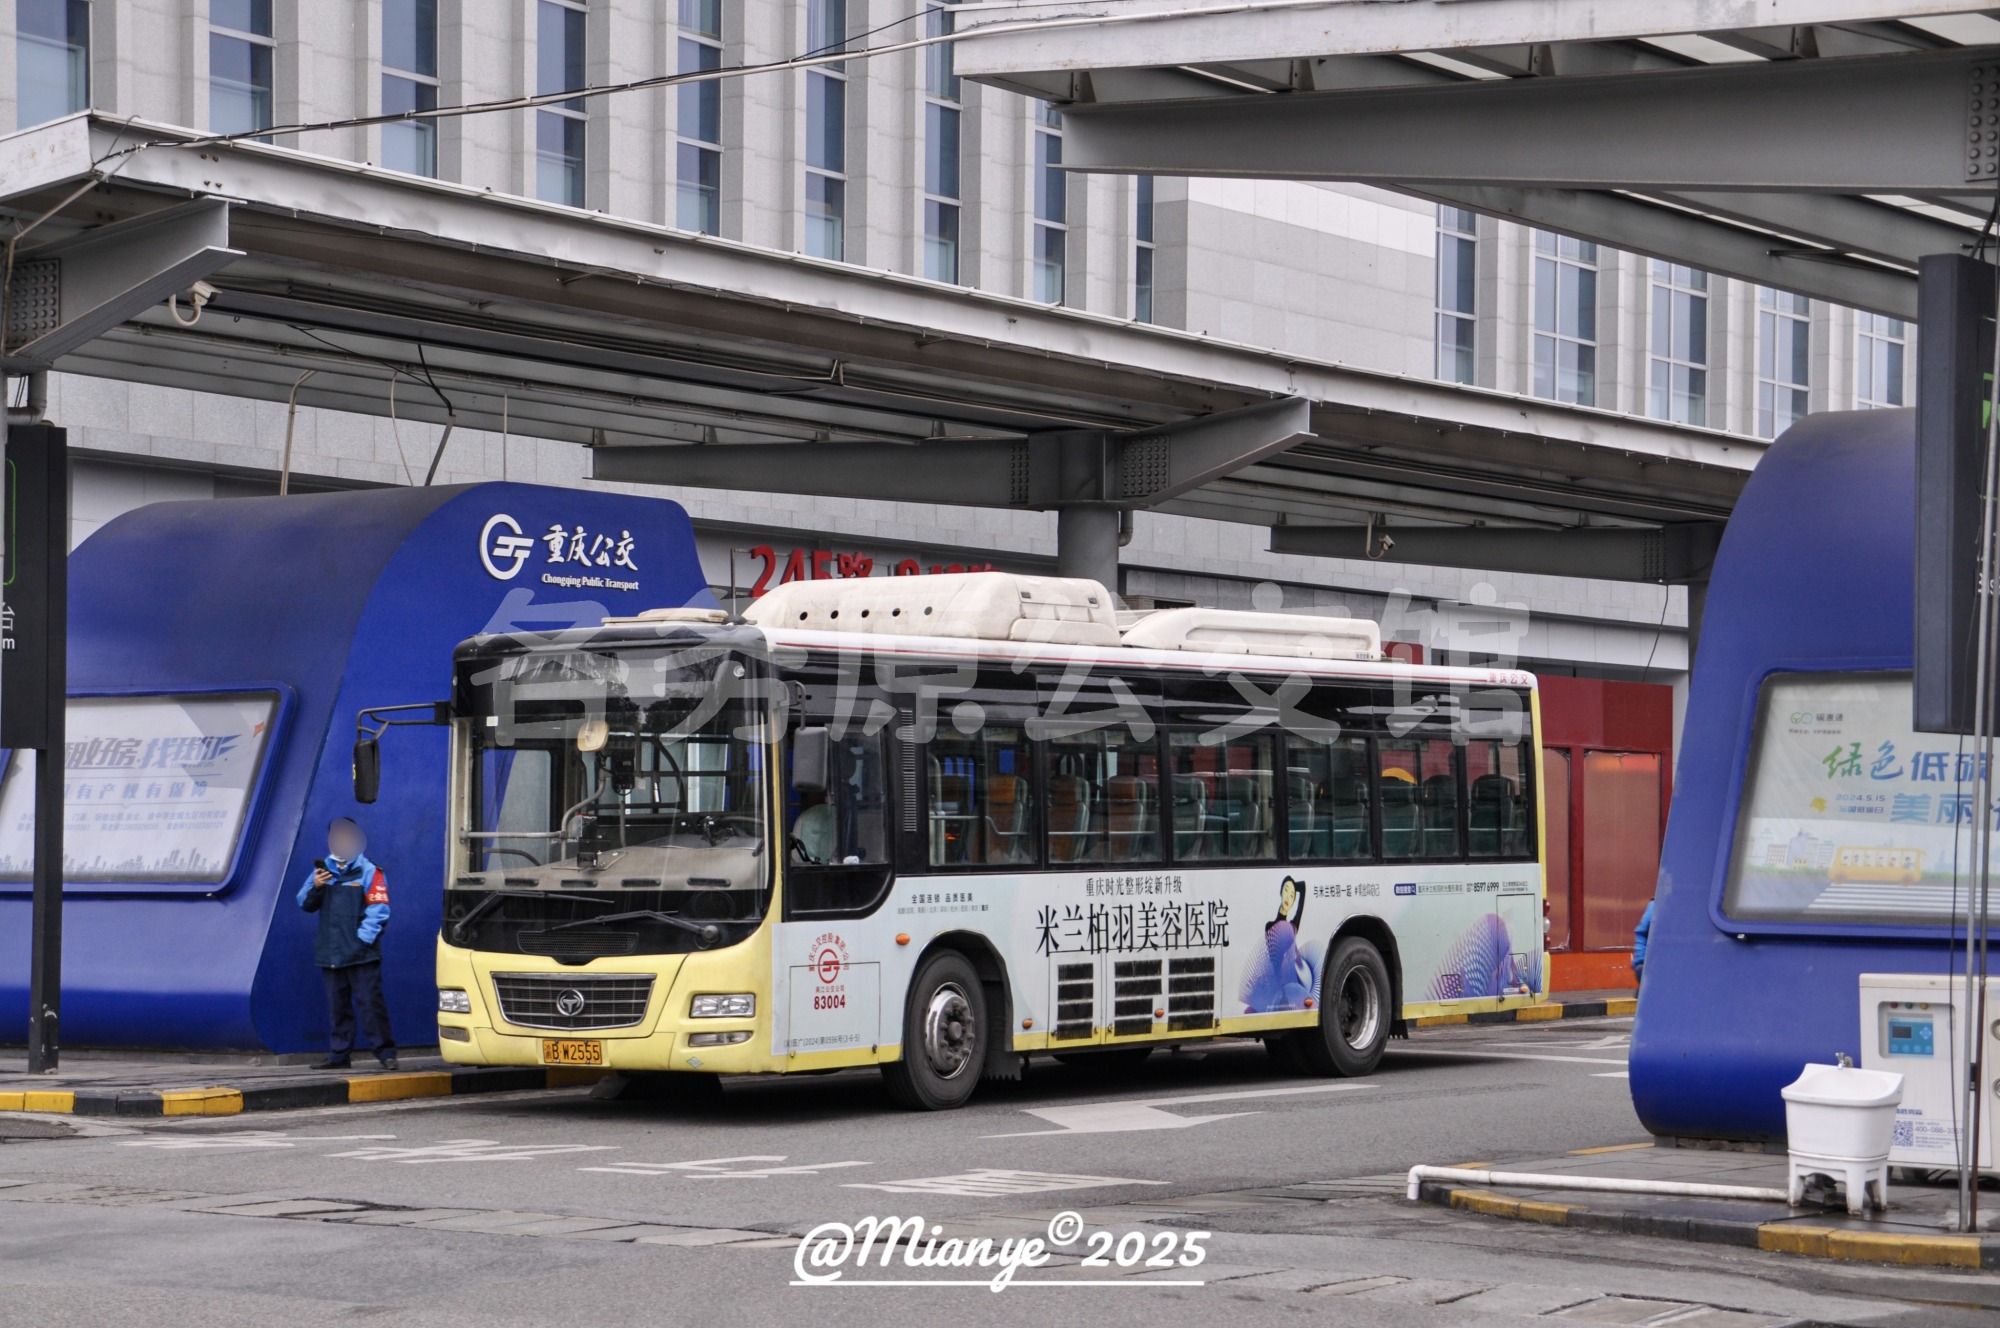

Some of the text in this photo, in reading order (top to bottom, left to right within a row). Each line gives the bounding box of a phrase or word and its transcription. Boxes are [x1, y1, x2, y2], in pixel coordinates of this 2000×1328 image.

[542, 524, 639, 571] 重庆公交
[542, 573, 640, 591] Chongqing Public Transport
[1086, 876, 1183, 896] 重庆时光整形绽新升级
[1035, 899, 1230, 957] 米兰柏羽美容医院
[814, 995, 846, 1010] 83004
